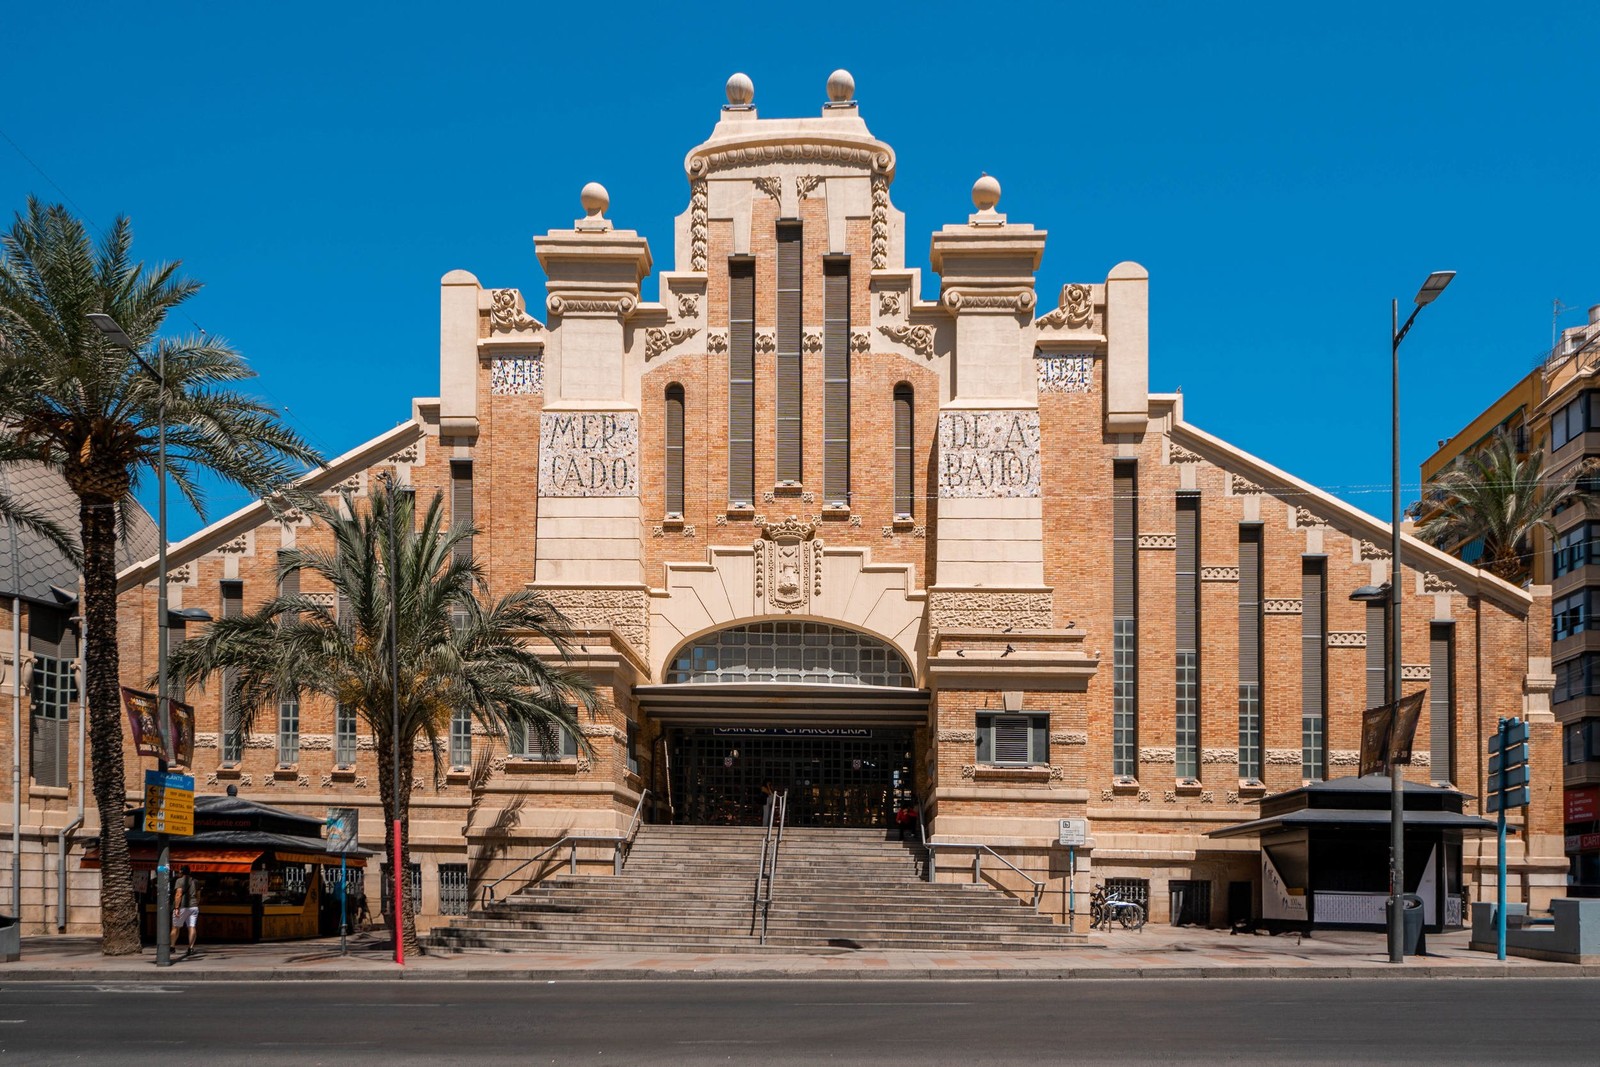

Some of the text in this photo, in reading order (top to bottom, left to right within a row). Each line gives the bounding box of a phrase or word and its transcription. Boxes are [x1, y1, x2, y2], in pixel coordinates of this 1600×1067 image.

[950, 414, 990, 449] DE
[552, 455, 628, 490] CADO
[945, 450, 1035, 486] BASTOS
